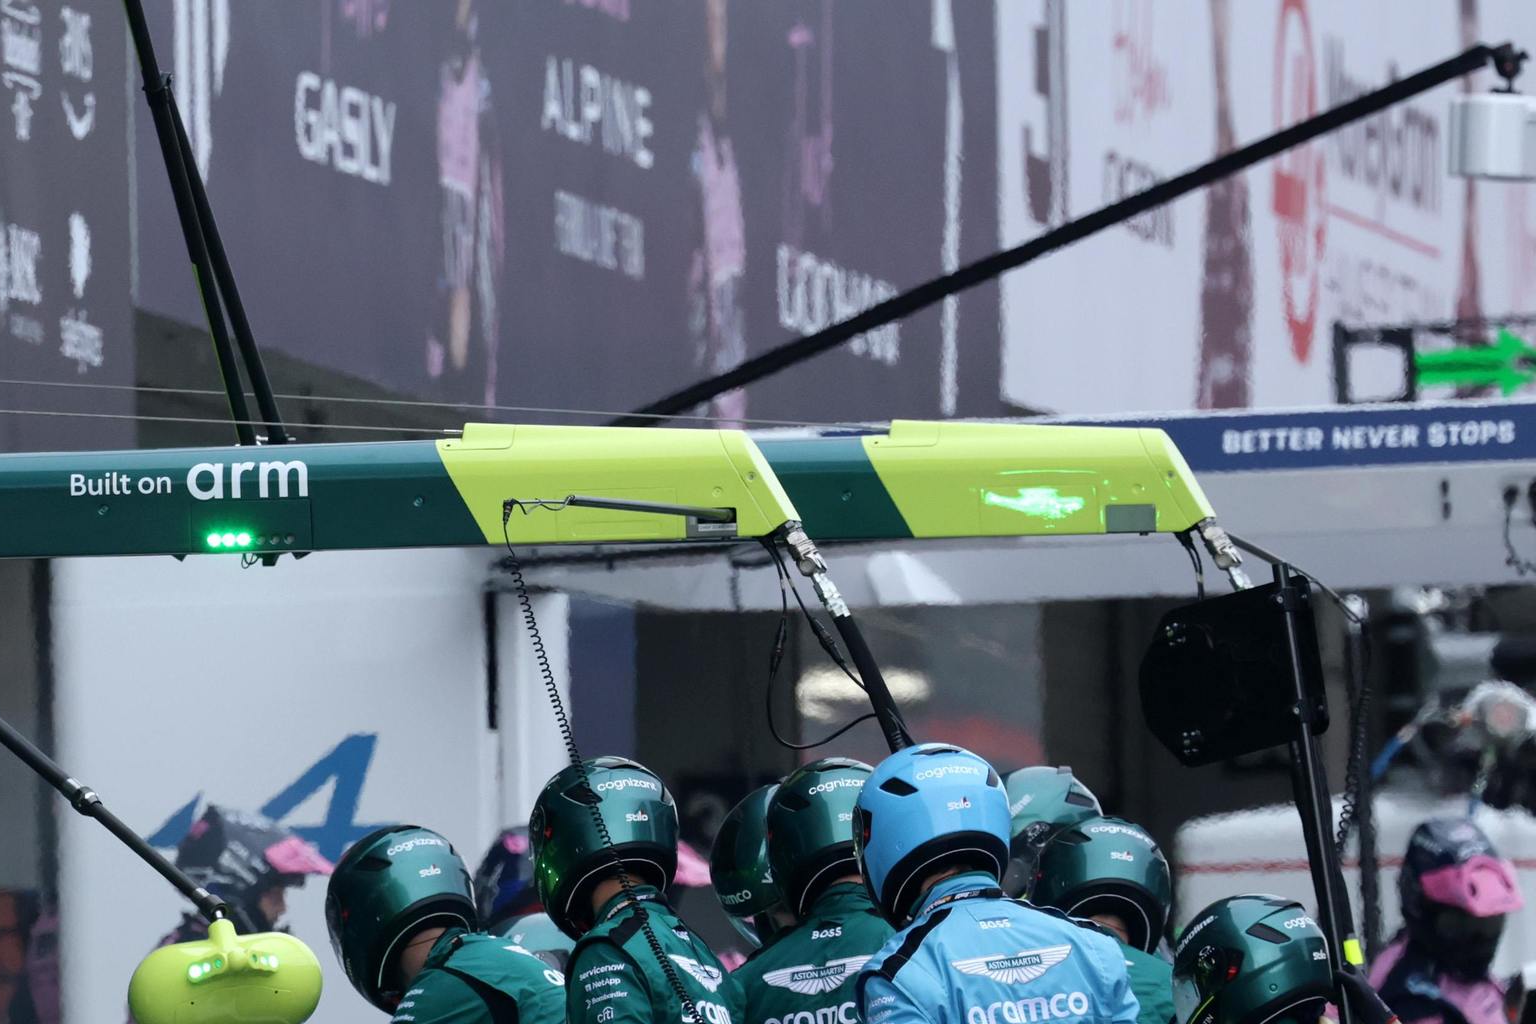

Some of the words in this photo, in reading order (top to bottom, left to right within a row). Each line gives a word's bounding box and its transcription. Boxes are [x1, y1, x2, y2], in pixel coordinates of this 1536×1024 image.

[542, 55, 655, 169] ALPINE
[295, 72, 396, 186] GASLY
[1223, 428, 1324, 454] BETTER
[1332, 424, 1420, 449] NEVER
[1427, 419, 1516, 447] STOPS
[70, 472, 132, 497] Built
[138, 475, 172, 495] on
[186, 460, 310, 500] arm
[916, 764, 981, 781] cognizant
[597, 779, 658, 793] cognizant
[387, 837, 444, 856] cognizant
[811, 926, 843, 939] BOSS
[978, 918, 1012, 930] BOSS
[988, 959, 1012, 971] ASTON
[1012, 954, 1042, 967] MARTIN
[579, 962, 626, 982] servicenow
[792, 969, 817, 982] ASTON
[818, 964, 847, 978] MARTIN
[592, 976, 622, 989] NetApp
